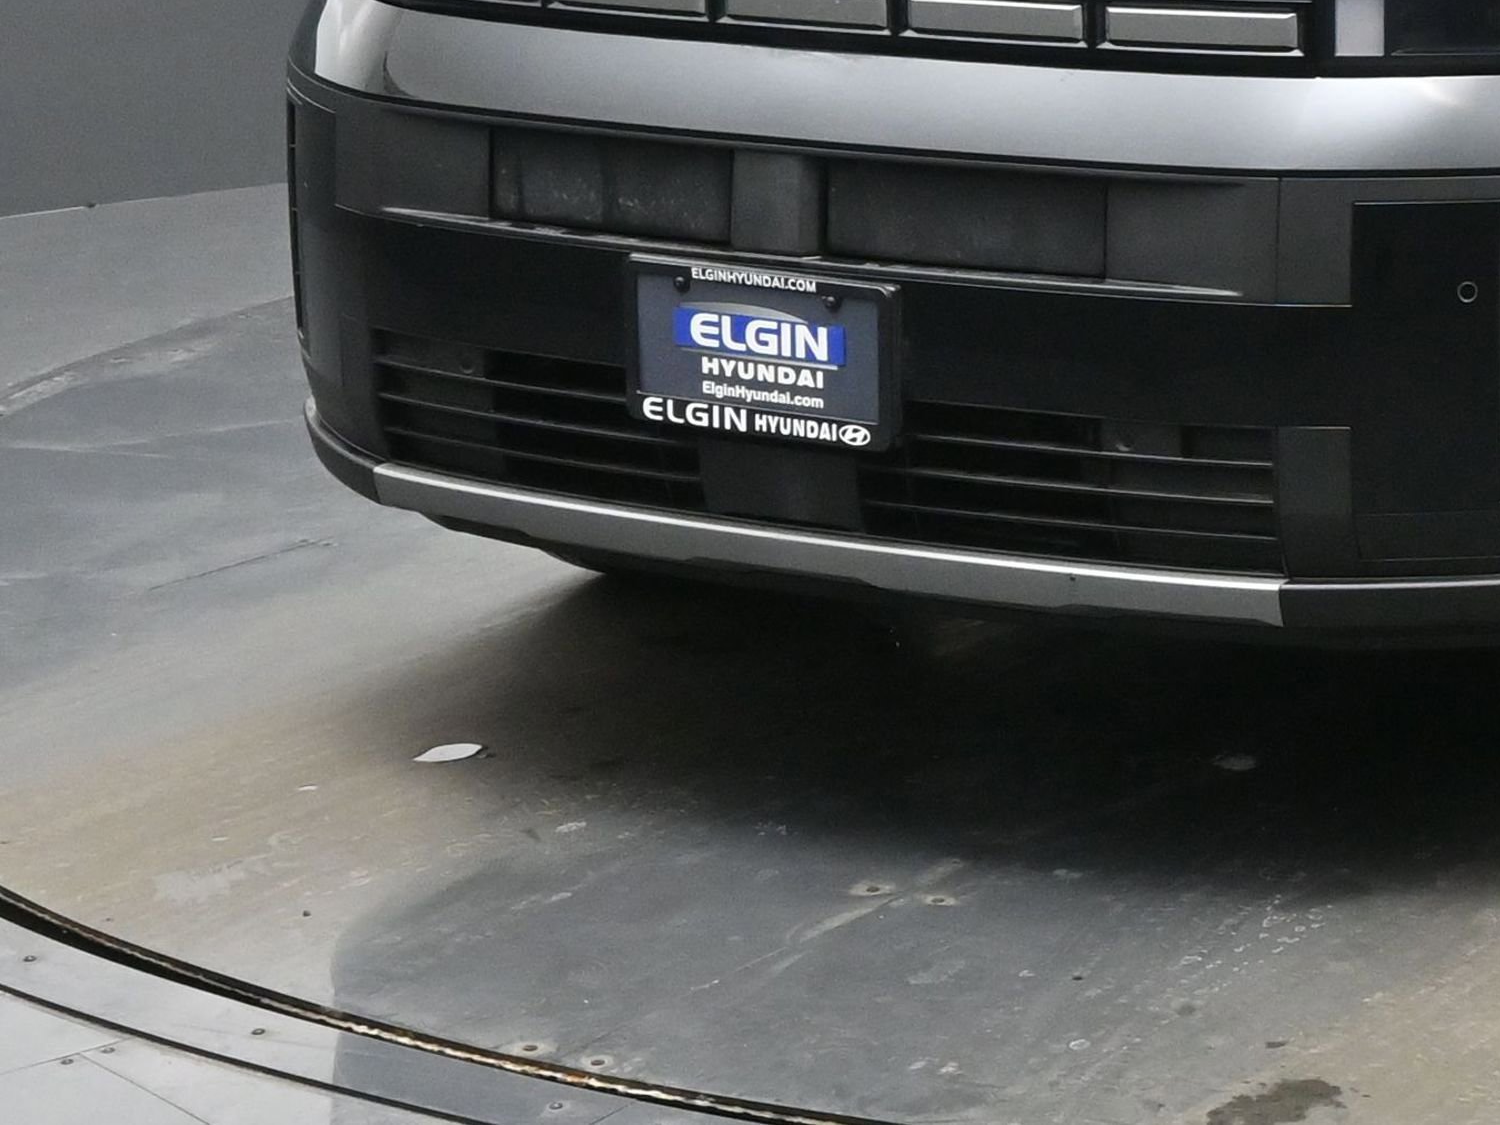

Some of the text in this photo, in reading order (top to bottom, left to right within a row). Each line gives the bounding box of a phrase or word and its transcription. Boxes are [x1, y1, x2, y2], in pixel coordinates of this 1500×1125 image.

[691, 267, 816, 293] ELGINHYUNDAI.COM
[690, 313, 829, 361] ELGIN
[701, 356, 824, 389] HYUNDAI
[702, 381, 824, 409] ElginHyundai.com
[642, 397, 838, 442] ELGIN HYUNDAI
